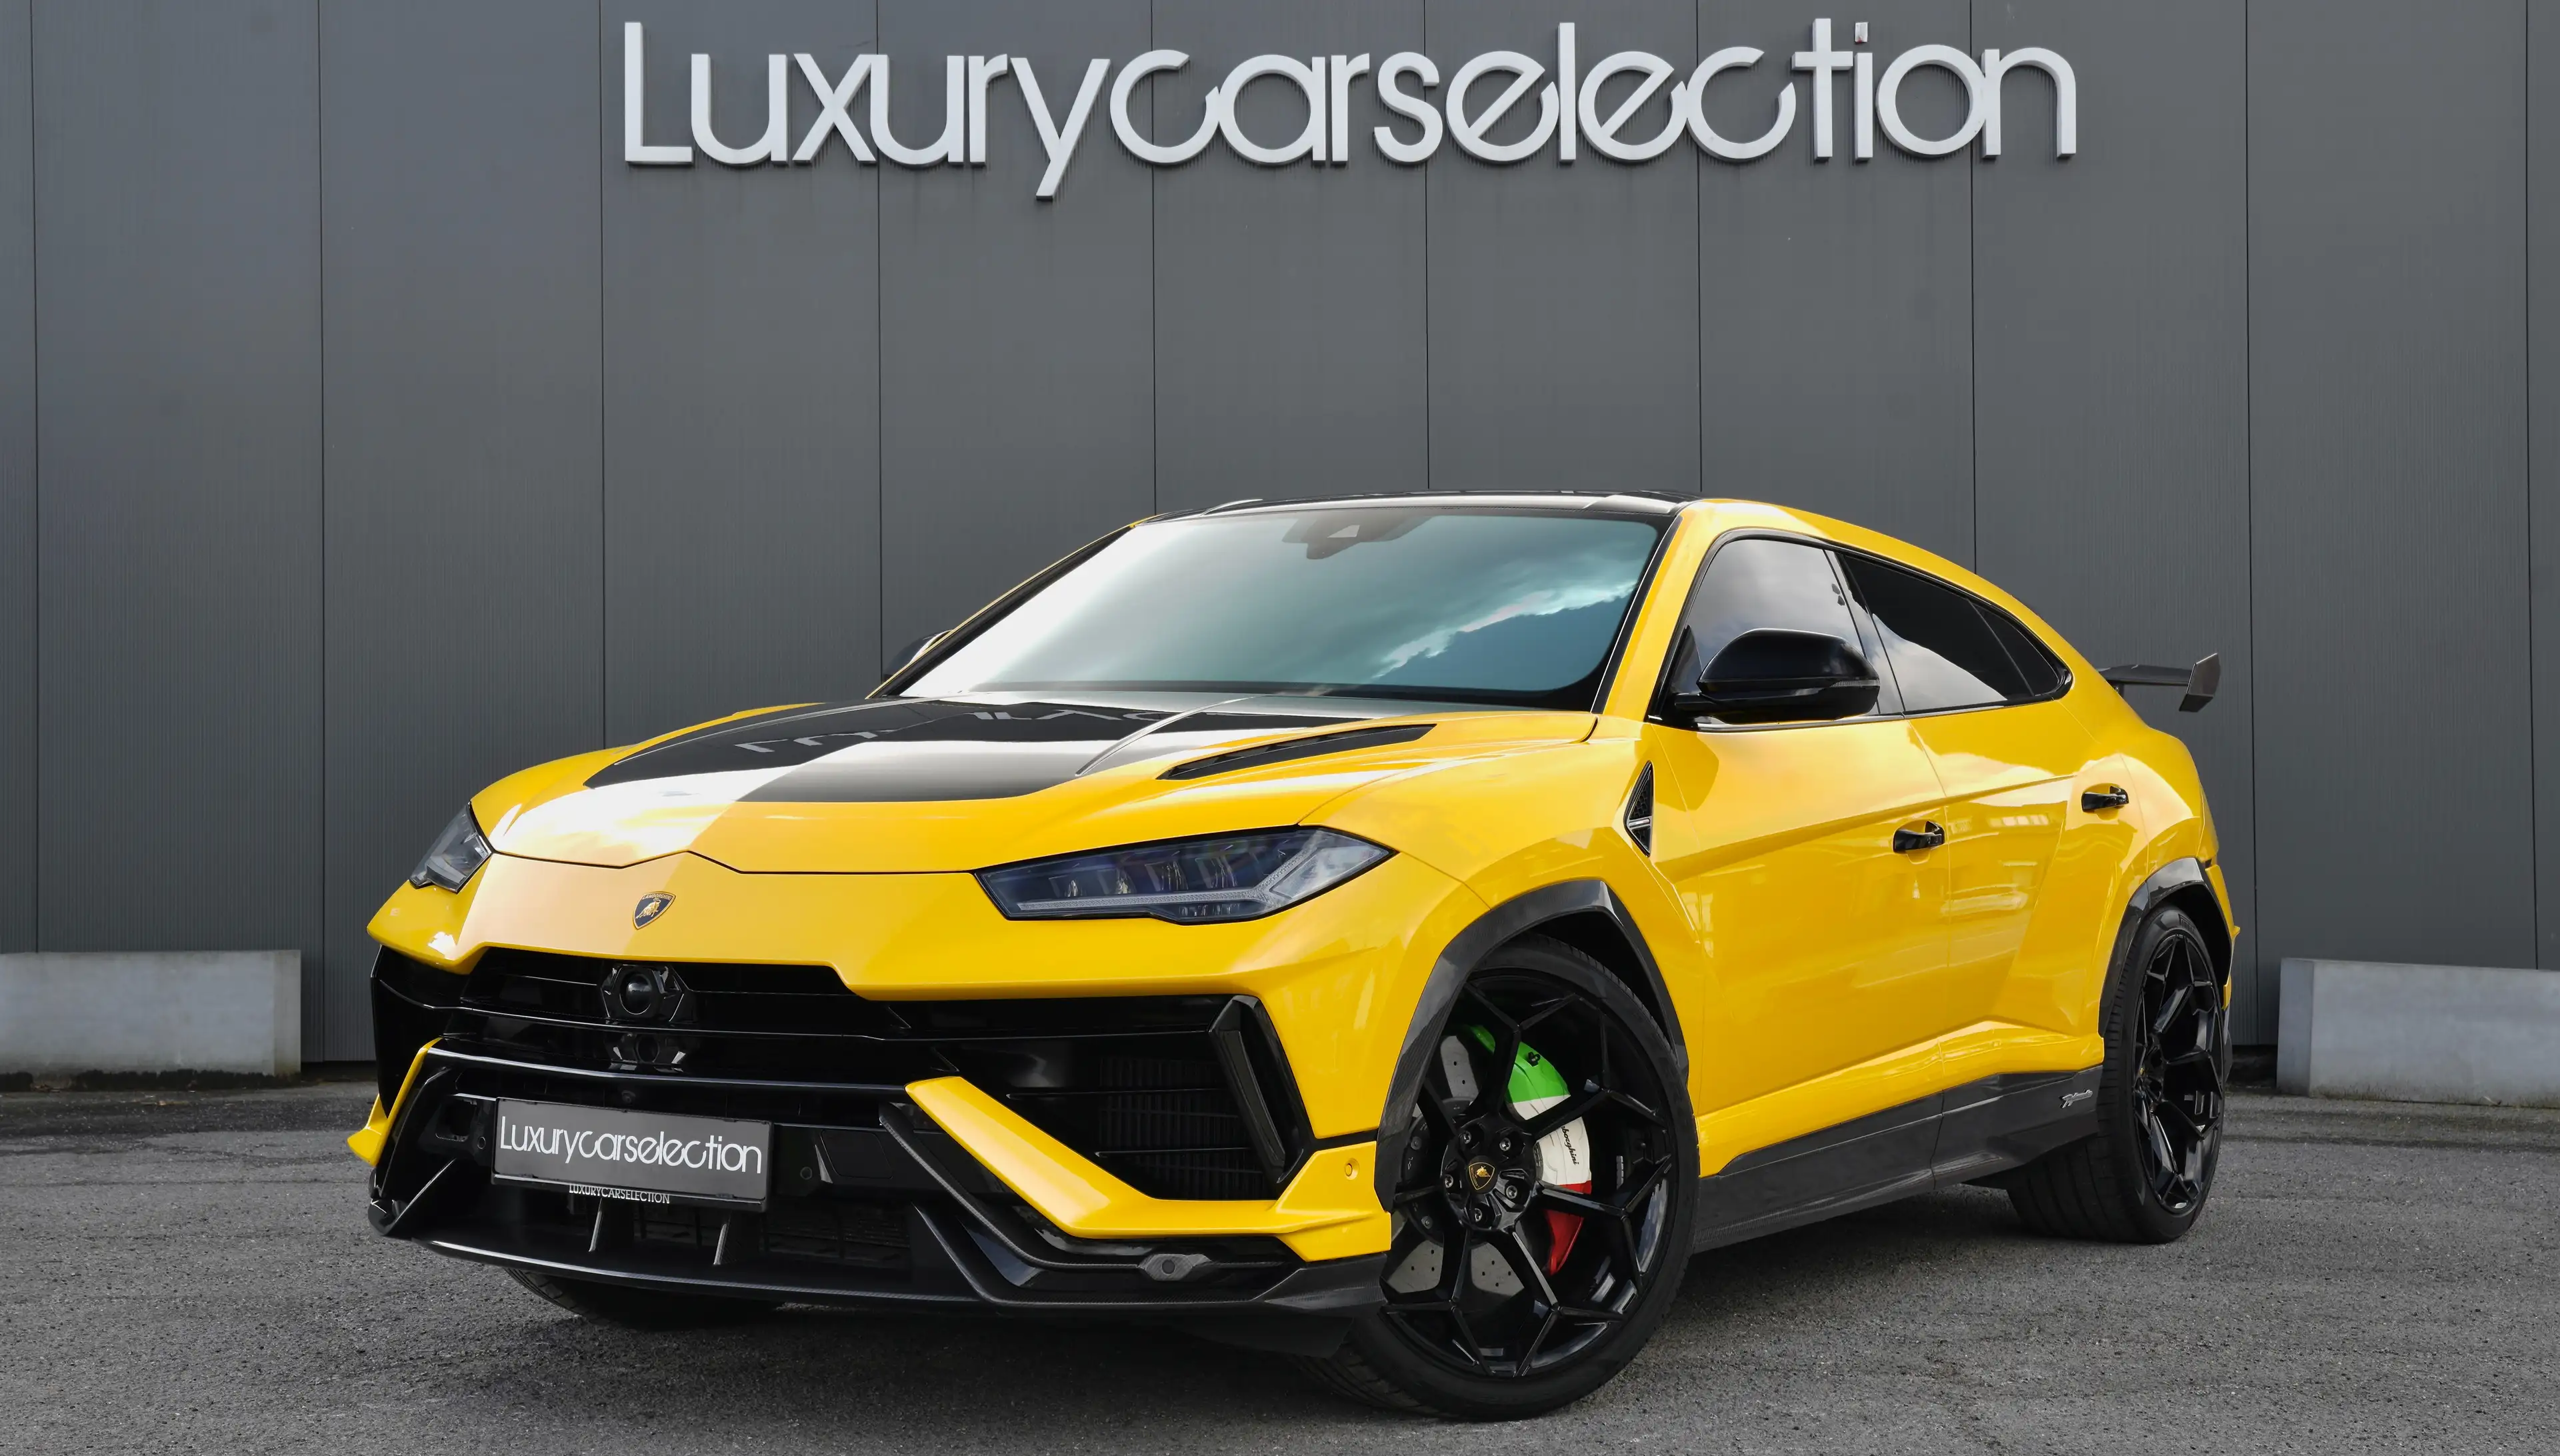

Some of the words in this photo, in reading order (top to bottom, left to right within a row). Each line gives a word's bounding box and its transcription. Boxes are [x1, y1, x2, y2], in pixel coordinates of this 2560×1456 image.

[625, 18, 2076, 199] Luxurycarselection
[642, 893, 673, 901] LAMBORGHINI
[500, 1116, 762, 1174] Luxurycarselection
[1561, 1126, 1579, 1165] borghini
[569, 1184, 670, 1204] LUXURYCARSELECTION
